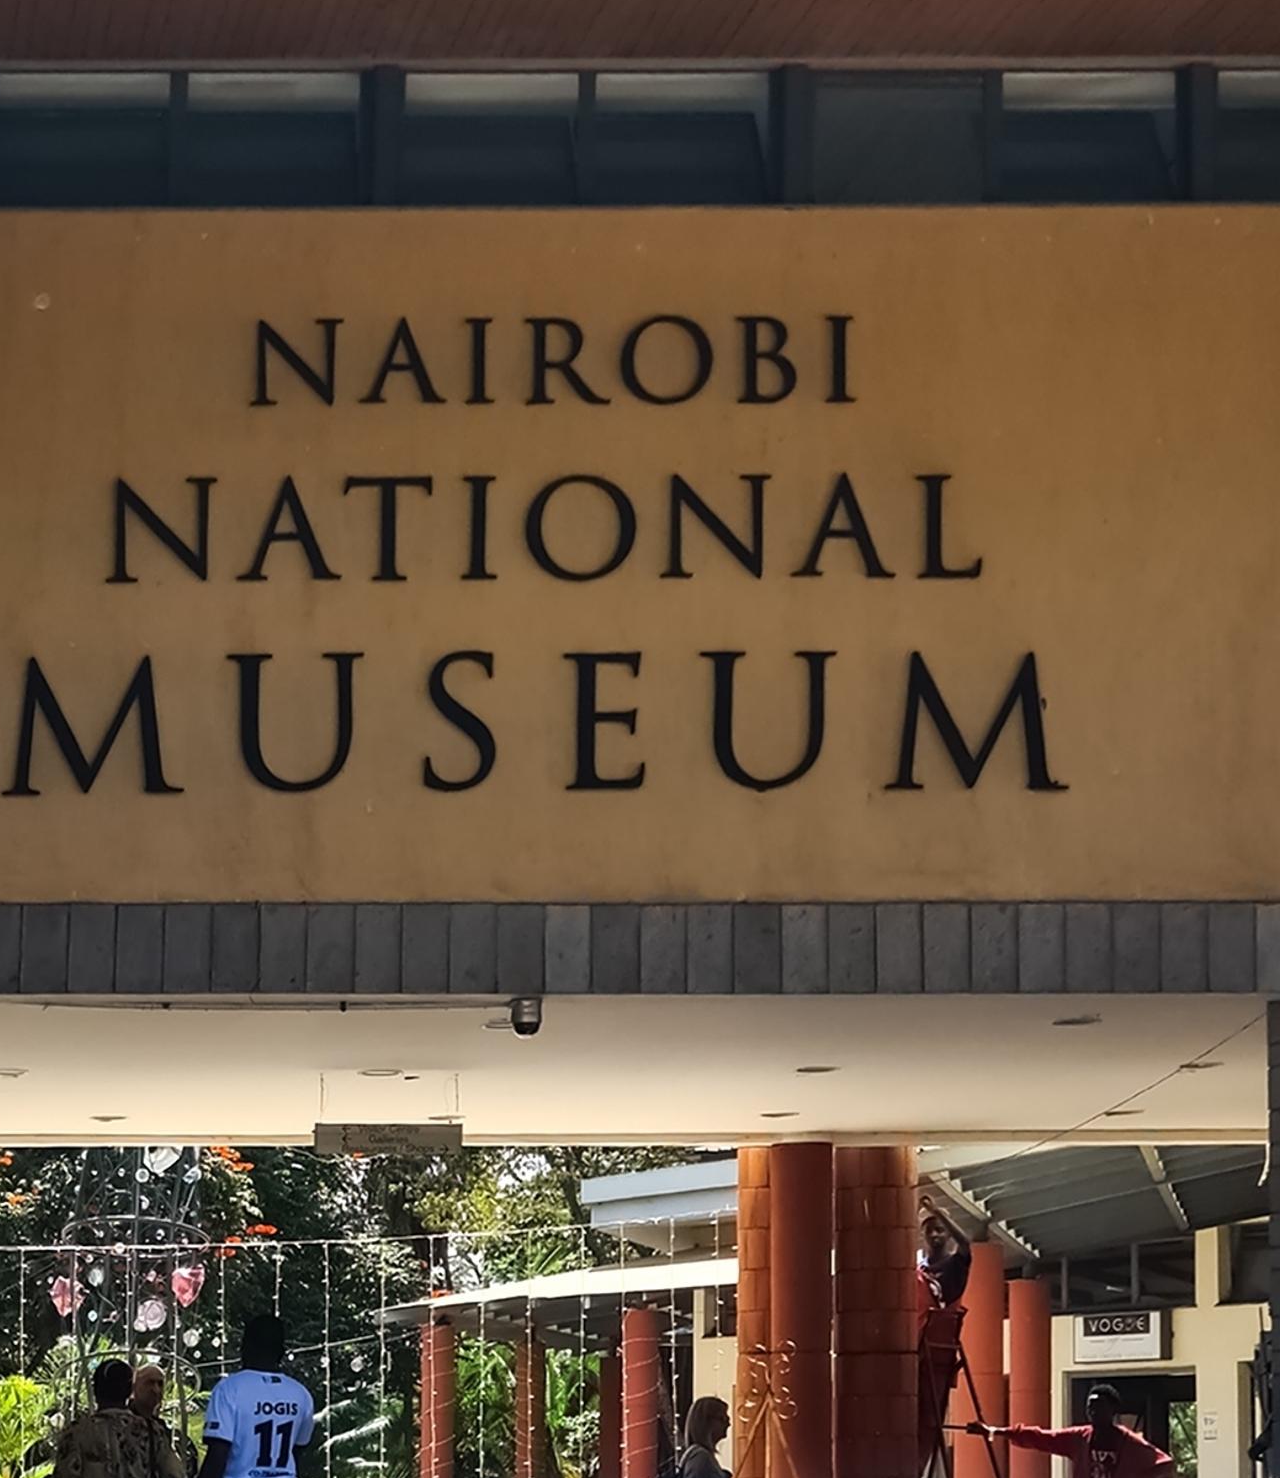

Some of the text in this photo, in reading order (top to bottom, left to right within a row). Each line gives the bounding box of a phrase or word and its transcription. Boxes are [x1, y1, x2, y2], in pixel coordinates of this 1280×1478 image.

[250, 315, 857, 408] NAIROBI
[106, 473, 984, 585] NATIONAL
[2, 651, 1070, 798] MUSEUM
[254, 1402, 298, 1415] JOGIS
[254, 1419, 294, 1468] 11
